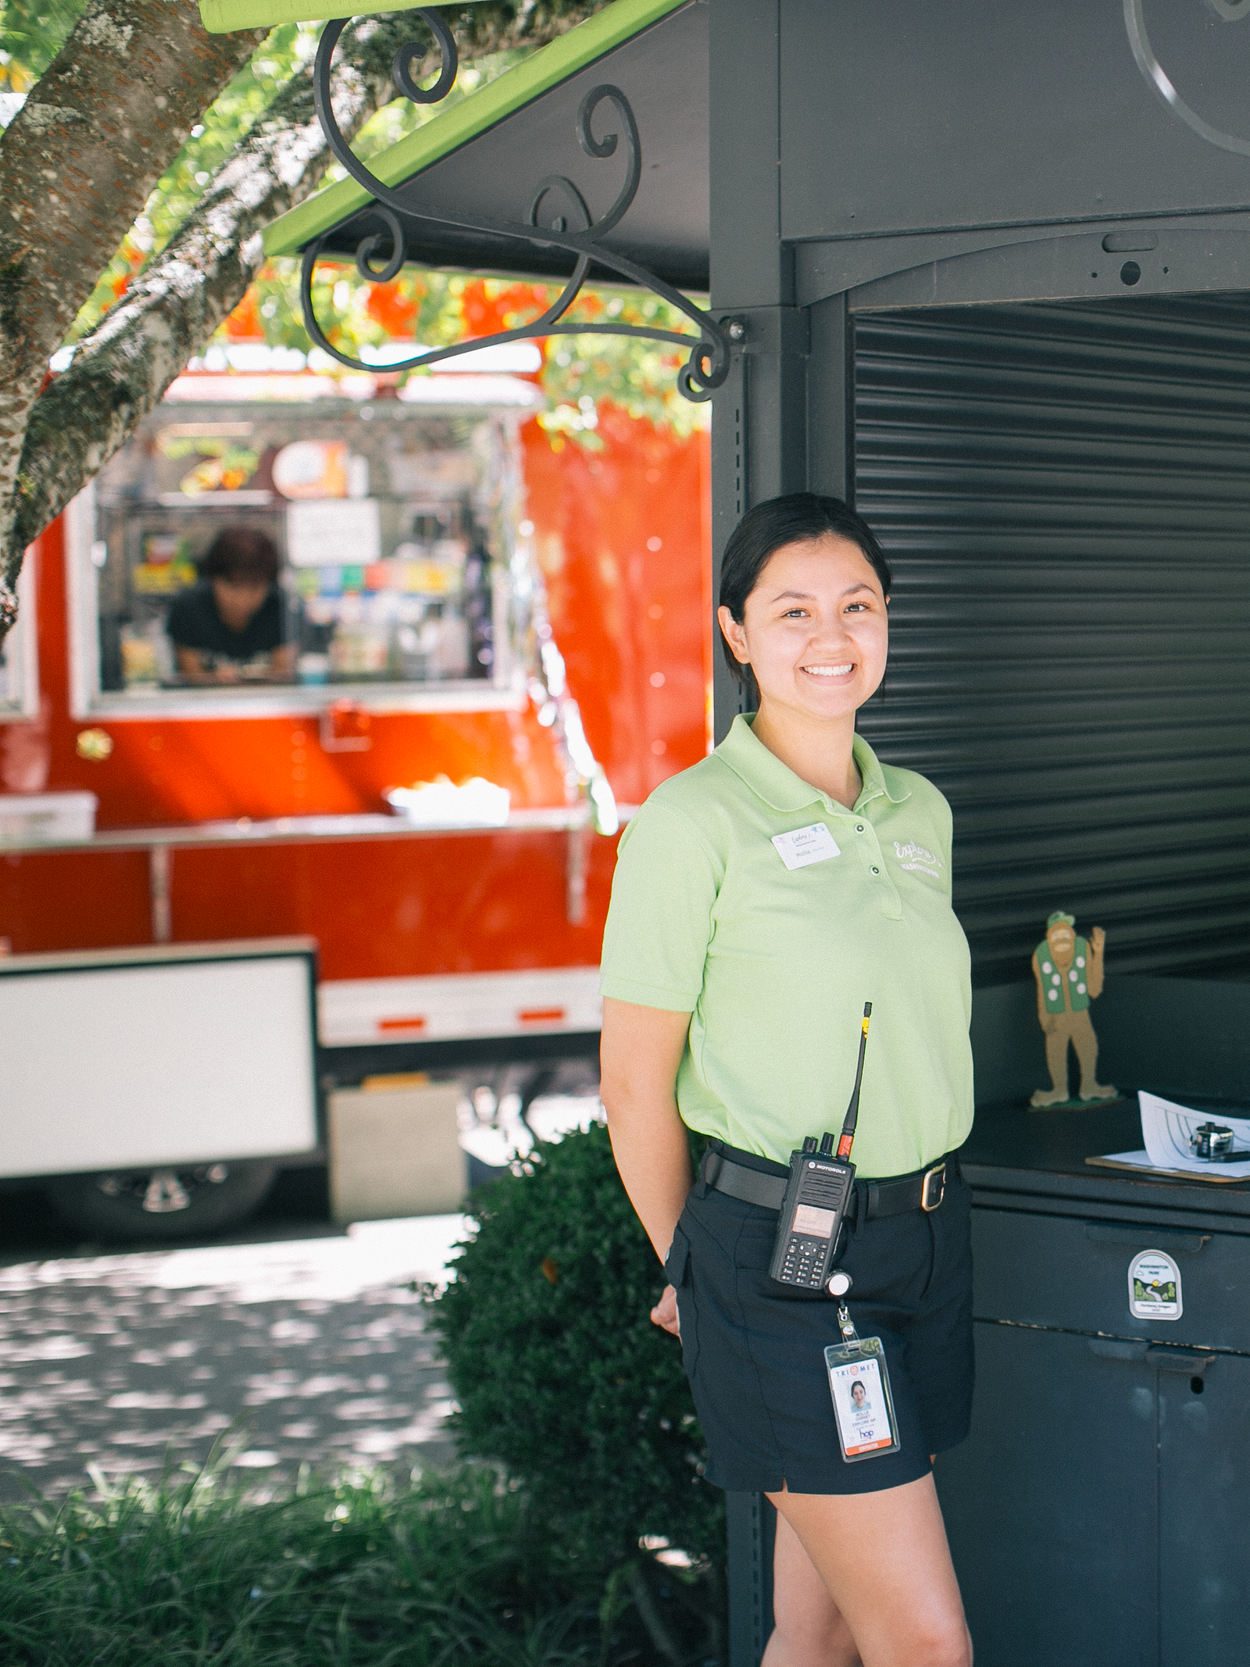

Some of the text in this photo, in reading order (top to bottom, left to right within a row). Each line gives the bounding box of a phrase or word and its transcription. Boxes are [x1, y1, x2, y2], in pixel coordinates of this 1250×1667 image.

[816, 1164, 846, 1174] MOTOROLA
[836, 1363, 875, 1378] TRI MET
